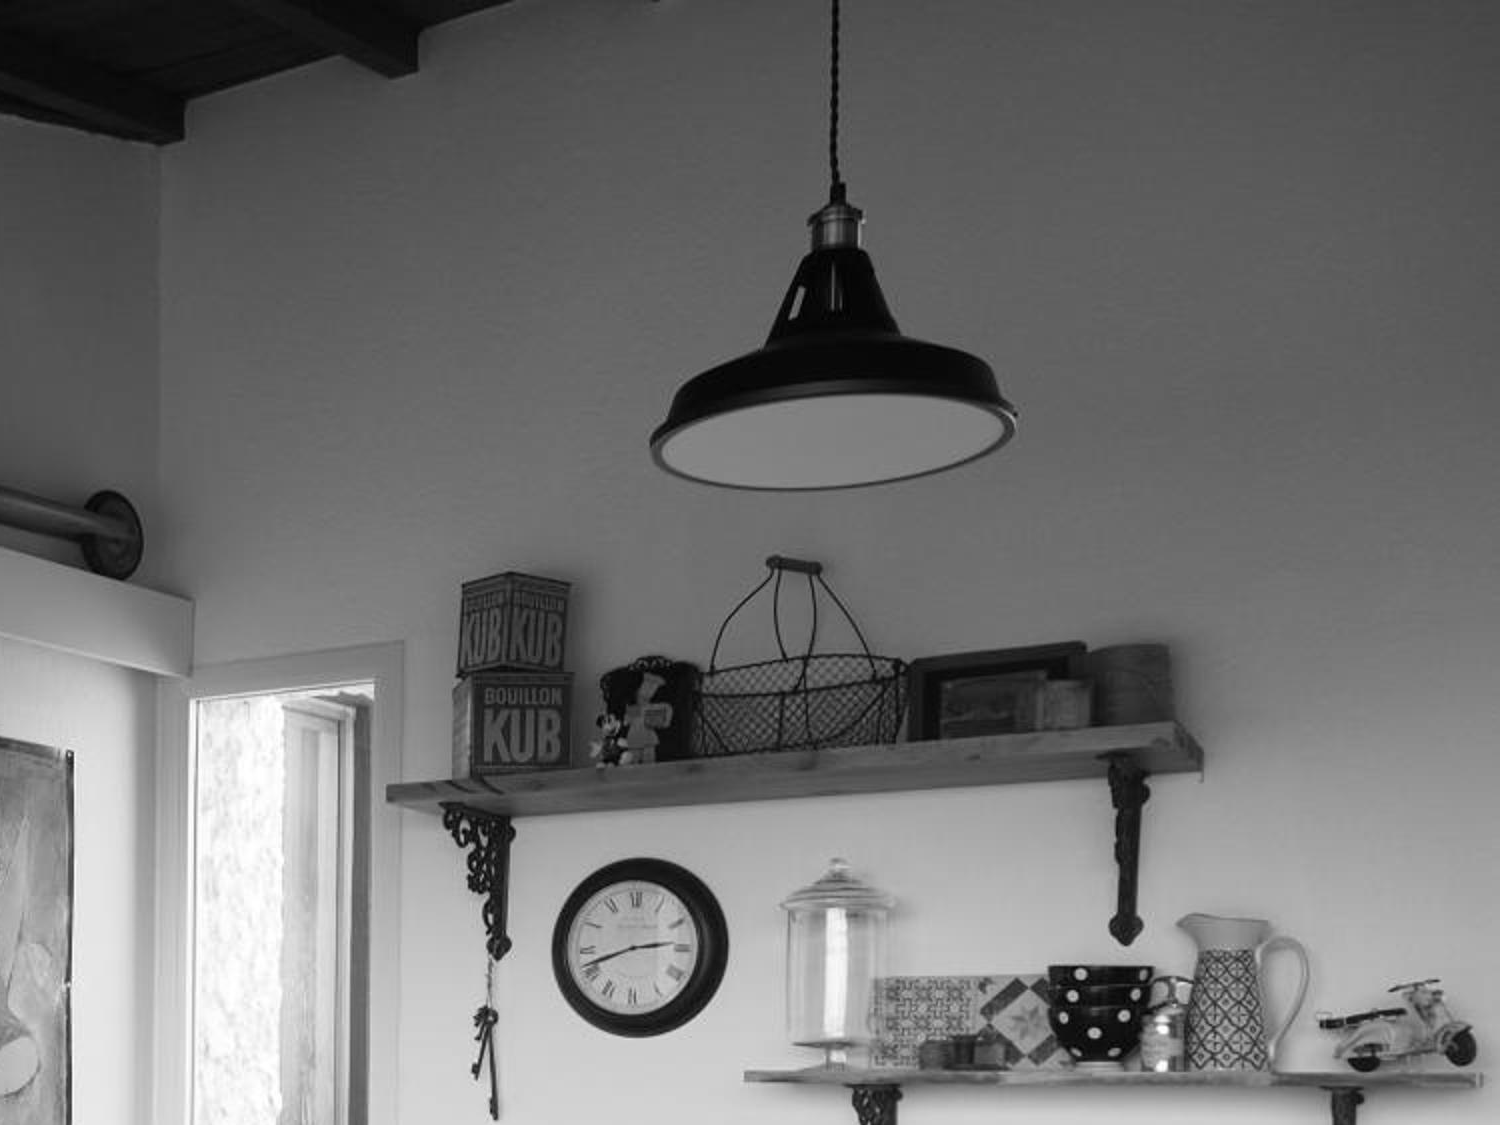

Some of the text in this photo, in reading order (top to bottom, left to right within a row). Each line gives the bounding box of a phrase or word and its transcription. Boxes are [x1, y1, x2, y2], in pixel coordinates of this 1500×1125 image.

[458, 608, 502, 669] KUB
[509, 604, 564, 670] KUB
[484, 686, 564, 706] BOUILLON
[482, 707, 562, 764] KUB
